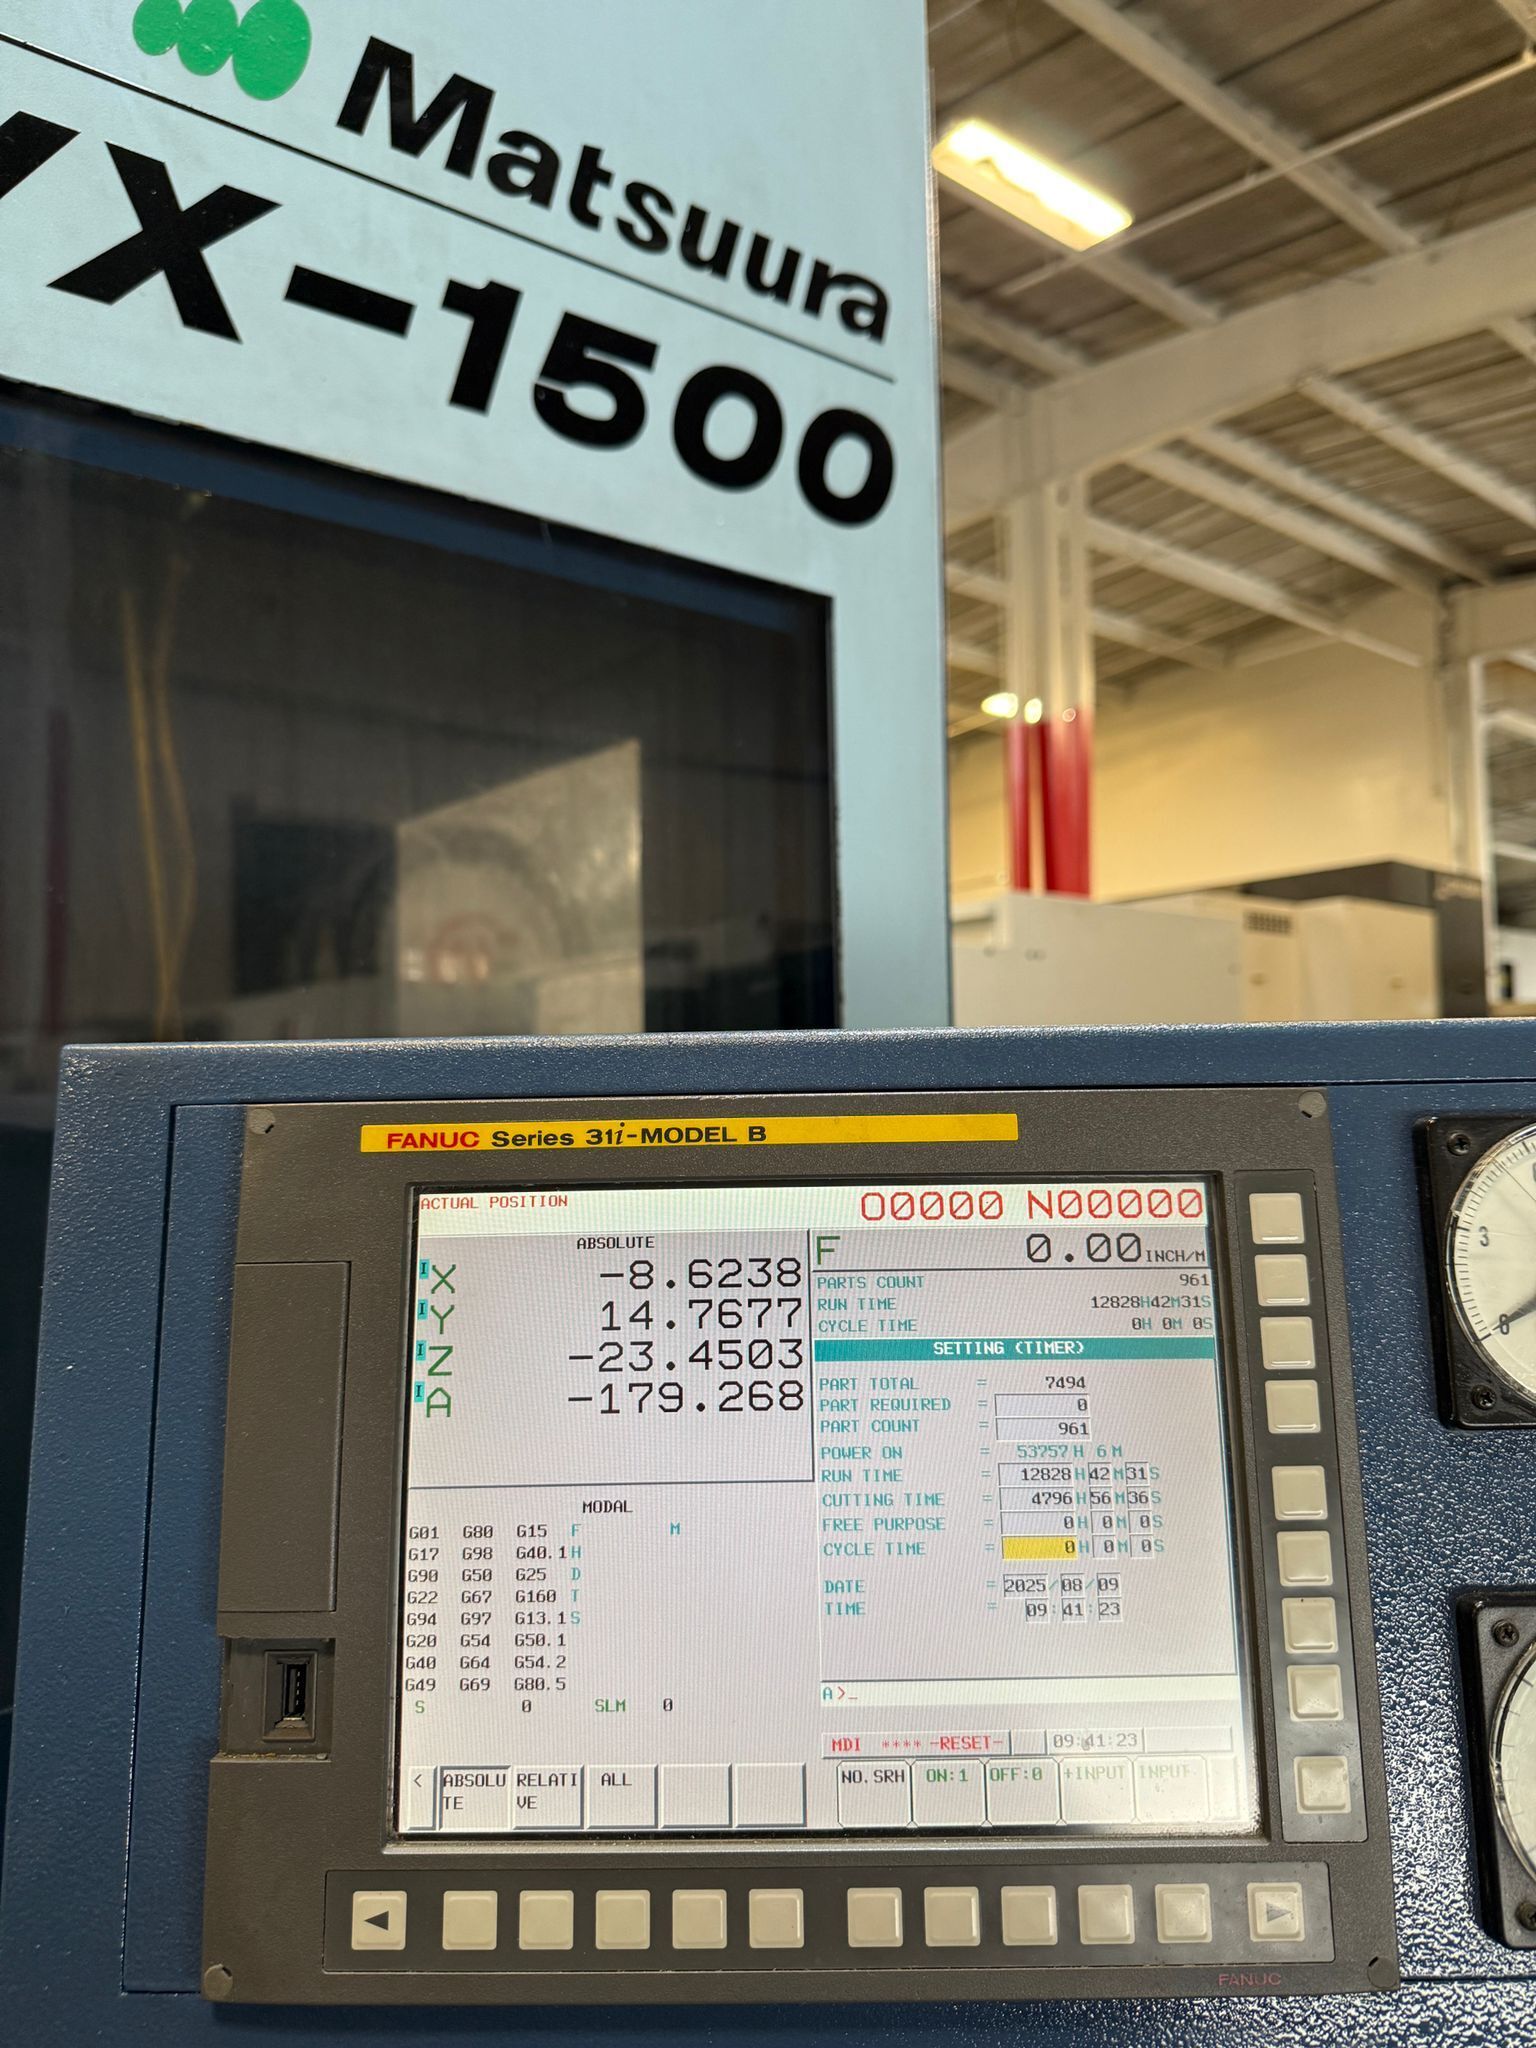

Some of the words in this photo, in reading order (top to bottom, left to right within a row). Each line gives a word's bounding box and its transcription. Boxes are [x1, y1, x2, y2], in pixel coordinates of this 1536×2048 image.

[337, 36, 890, 344] Matsuura
[387, 1131, 479, 1149] FANUC
[491, 1130, 574, 1147] Series
[586, 1122, 737, 1144] 31i-MODEL
[748, 1126, 766, 1142] B
[420, 1196, 479, 1210] ACTUAL
[489, 1194, 568, 1208] POSITION
[576, 1236, 655, 1249] ABSOLUTE
[1479, 1226, 1490, 1247] 3
[816, 1235, 840, 1265] F
[1026, 1233, 1141, 1263] 0.00
[1146, 1250, 1206, 1262] INCH/M
[431, 1264, 456, 1294] X
[600, 1257, 801, 1289] -8.6238
[817, 1277, 866, 1289] PARTS
[876, 1276, 924, 1289] COUNT
[1179, 1274, 1209, 1286] 961
[818, 1298, 848, 1311] RUN
[858, 1298, 896, 1310] TIME
[430, 1305, 455, 1334] Y
[601, 1298, 802, 1331] 14.7677
[818, 1320, 867, 1332] CYCLE
[879, 1319, 917, 1332] TIME
[933, 1342, 1004, 1355] SETTING
[1015, 1341, 1085, 1355] (TIMER)
[428, 1346, 453, 1376] Z
[569, 1339, 803, 1372] -23.4503
[819, 1378, 858, 1391] PART
[870, 1377, 919, 1390] TOTAL
[1045, 1376, 1086, 1389] 7494
[426, 1387, 451, 1417] A
[568, 1381, 804, 1414] -179.268
[820, 1399, 859, 1412] PART
[870, 1398, 951, 1412] REQUIRED
[1077, 1399, 1087, 1411] 0
[820, 1420, 859, 1433] PART
[871, 1419, 920, 1432] COUNT
[1058, 1422, 1089, 1435] 961
[821, 1446, 871, 1460] POWER
[882, 1446, 903, 1459] ON
[822, 1469, 853, 1482] RUN
[863, 1468, 903, 1482] TIME
[1021, 1467, 1072, 1481] 12828
[823, 1493, 894, 1507] CUTTING
[903, 1493, 945, 1506] TIME
[1032, 1492, 1073, 1505] 4796
[582, 1501, 633, 1514] MODAL
[409, 1526, 439, 1539] G01
[463, 1525, 493, 1538] G80
[517, 1525, 547, 1538] G15
[571, 1524, 582, 1537] F
[670, 1523, 680, 1535] M
[823, 1518, 864, 1531] FREE
[874, 1517, 945, 1531] PURPOSE
[408, 1548, 439, 1561] G17
[462, 1547, 493, 1560] G98
[571, 1546, 581, 1559] H
[824, 1543, 874, 1556] CYCLE
[885, 1542, 926, 1556] TIME
[408, 1569, 438, 1583] G90
[462, 1569, 492, 1582] G50
[516, 1568, 547, 1581] G25
[571, 1568, 581, 1580] D
[825, 1580, 865, 1593] DATE
[407, 1591, 438, 1604] G22
[461, 1591, 492, 1603] G67
[515, 1590, 557, 1603] G160
[571, 1589, 580, 1602] T
[825, 1602, 865, 1616] TIME
[407, 1613, 437, 1626] G94
[461, 1612, 492, 1625] G97
[571, 1612, 580, 1624] S
[406, 1635, 437, 1648] G20
[460, 1634, 491, 1647] G54
[406, 1656, 436, 1669] G40
[460, 1656, 490, 1669] G64
[405, 1678, 436, 1691] G49
[460, 1678, 490, 1691] G69
[415, 1701, 425, 1714] S
[522, 1700, 532, 1713] 0
[595, 1699, 626, 1712] SLM
[663, 1699, 673, 1712] 0
[832, 1737, 861, 1752] MDI
[1054, 1733, 1138, 1748] 09:41:23
[443, 1773, 506, 1787] ABSOLU
[517, 1773, 577, 1787] RELATI
[601, 1772, 633, 1786] ALL
[926, 1768, 969, 1783] ON:1
[990, 1767, 1043, 1782] OFF:0
[443, 1796, 464, 1810] TE
[517, 1795, 538, 1810] VE
[1218, 1973, 1281, 1986] FANUC
